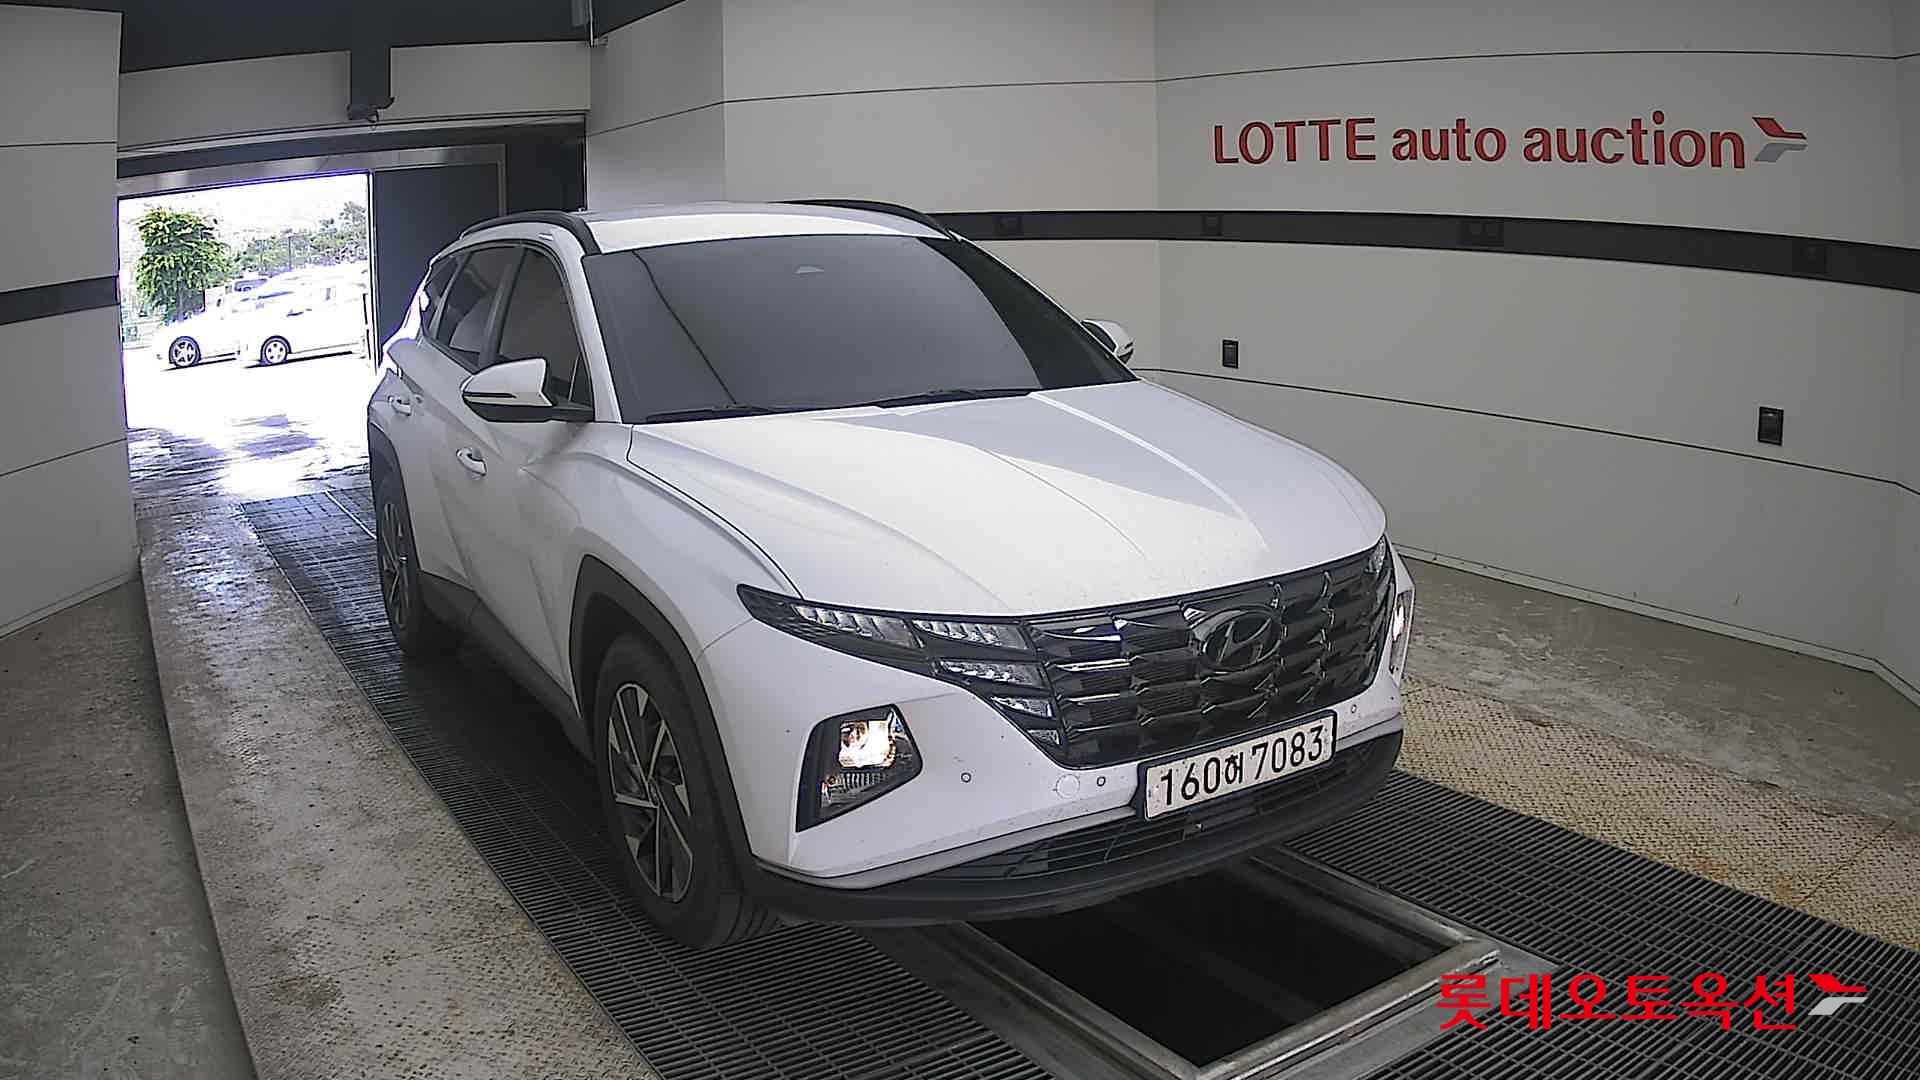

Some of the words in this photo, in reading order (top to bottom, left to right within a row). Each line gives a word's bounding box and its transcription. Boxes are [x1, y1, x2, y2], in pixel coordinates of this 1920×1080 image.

[1213, 117, 1376, 164] LOTTE
[1392, 118, 1507, 163] auto
[1523, 110, 1746, 169] auction
[1160, 751, 1244, 806] 160허
[1251, 725, 1324, 780] 7083
